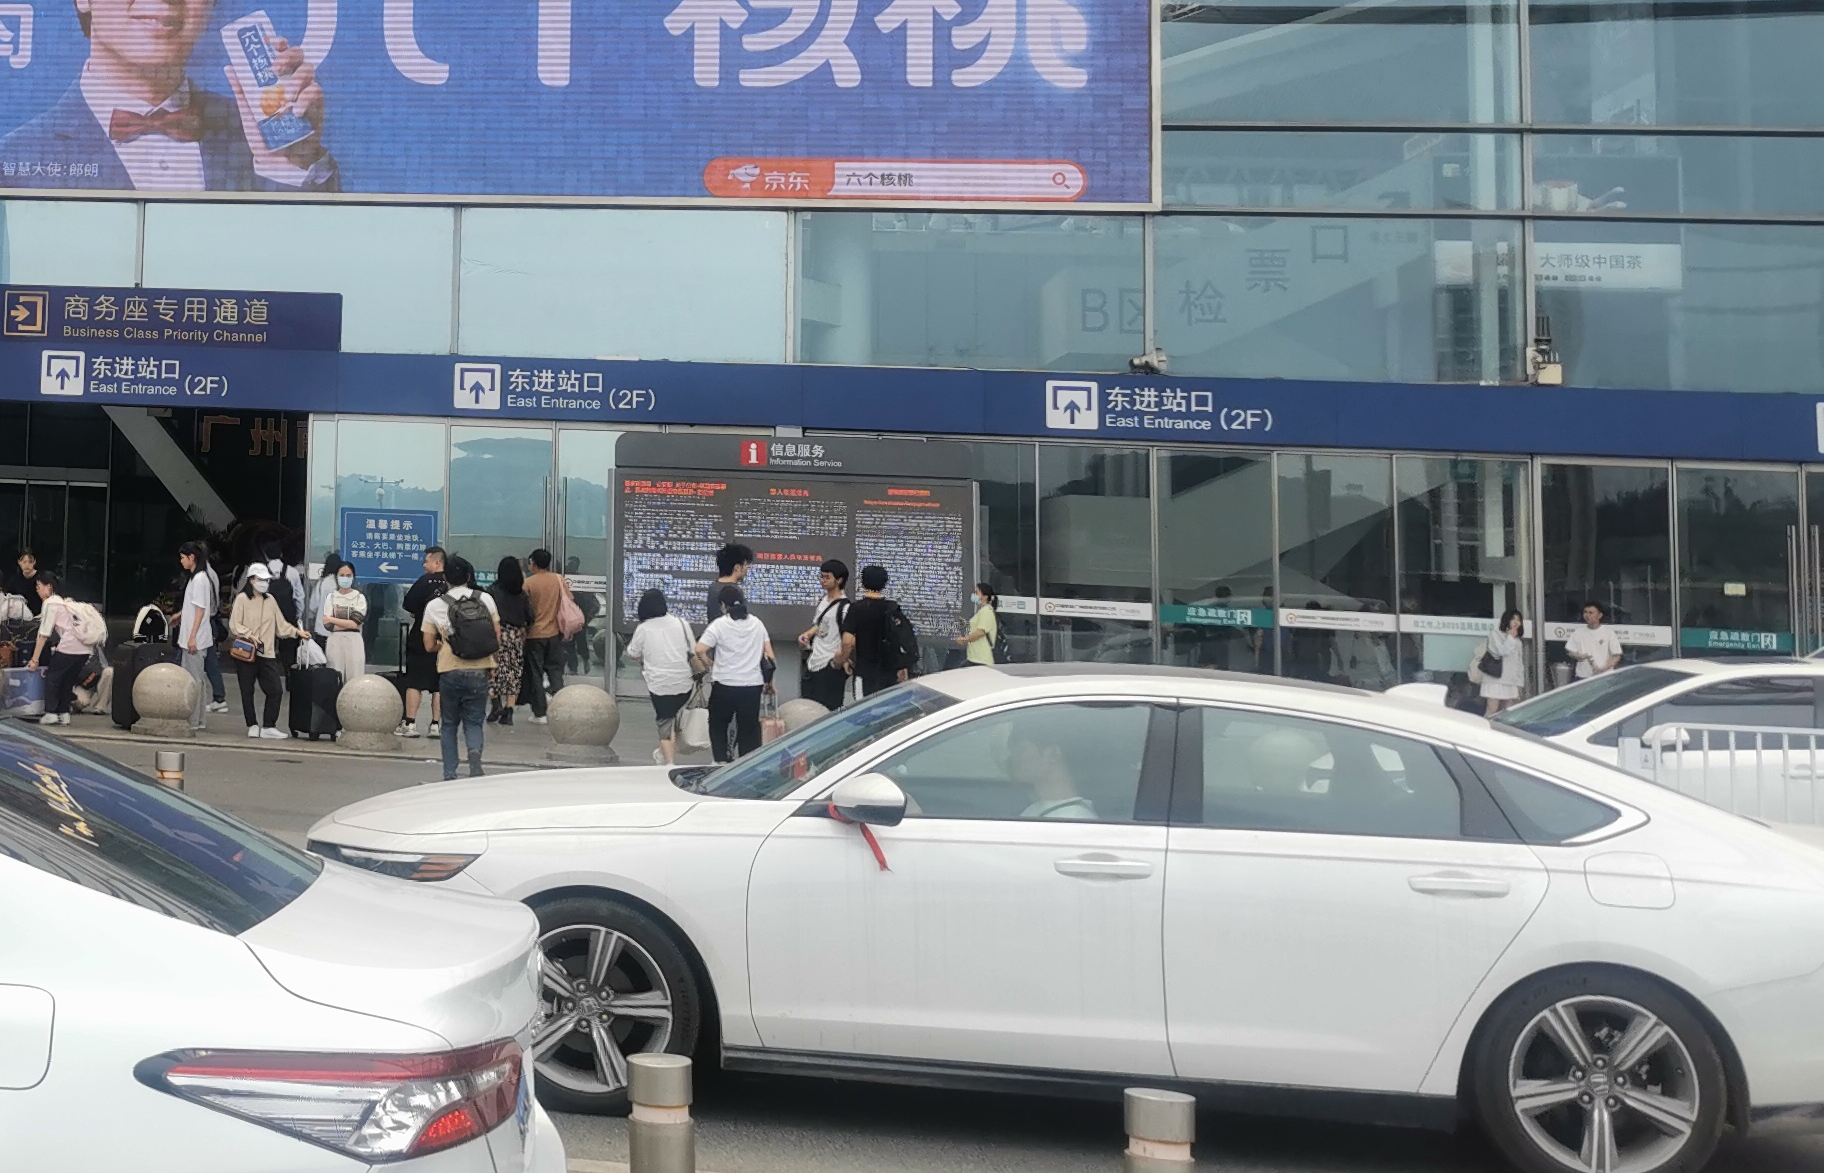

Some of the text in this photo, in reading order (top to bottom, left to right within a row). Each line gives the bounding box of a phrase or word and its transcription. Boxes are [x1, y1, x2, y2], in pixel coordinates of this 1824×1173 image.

[764, 171, 810, 191] 京东
[846, 172, 914, 187] 六个核桃
[64, 294, 270, 326] 商务座专用通道
[63, 326, 267, 343] Business Class Priority Channel
[90, 356, 180, 380] 东进站口
[89, 380, 178, 396] East Entrance
[507, 368, 604, 394] 东进站口
[507, 394, 602, 410] East Entrance
[1105, 386, 1213, 413] 东进站口
[1105, 414, 1212, 430] East Entrance
[200, 414, 308, 458] 广州
[770, 443, 825, 458] 信息服务
[769, 458, 843, 467] Information Service
